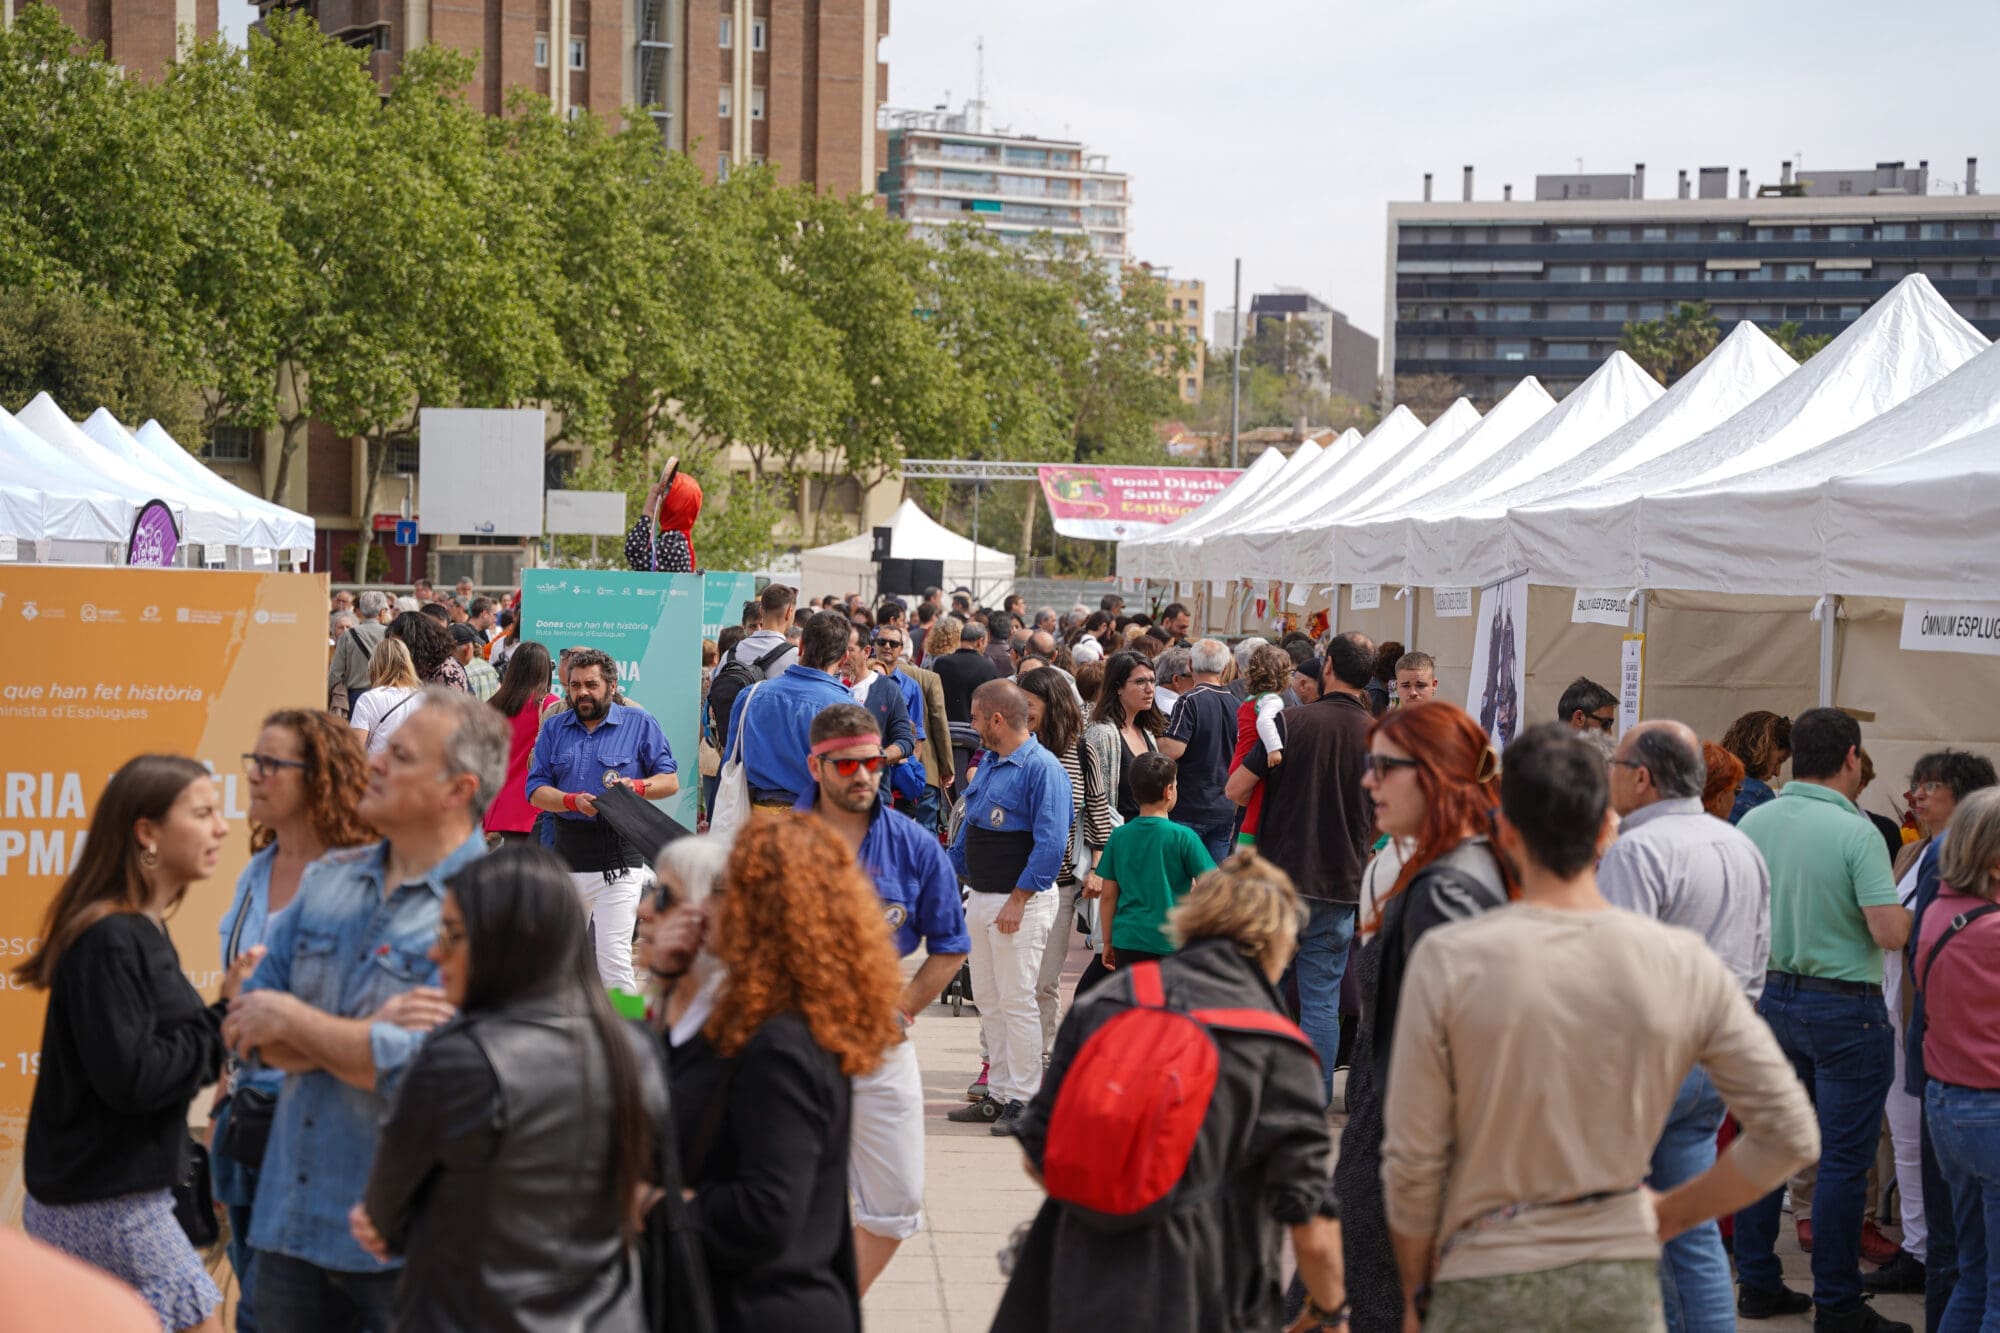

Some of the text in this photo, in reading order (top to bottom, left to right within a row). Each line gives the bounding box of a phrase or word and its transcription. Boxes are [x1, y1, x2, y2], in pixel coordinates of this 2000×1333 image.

[1112, 477, 1225, 490] Bona Diada
[1122, 488, 1214, 503] Sant Jor
[1121, 502, 1193, 516] Esplug
[536, 619, 564, 628] Dones
[566, 622, 582, 630] que
[584, 621, 600, 629] han
[602, 621, 615, 630] fet
[1921, 610, 2000, 640] ÒMNIUM ESPLUG
[553, 629, 585, 637] feminista
[585, 630, 625, 638] d'Esplugues
[3, 683, 203, 702] que han fet història
[51, 704, 149, 721] d'Esplugues
[0, 772, 87, 819] RIA
